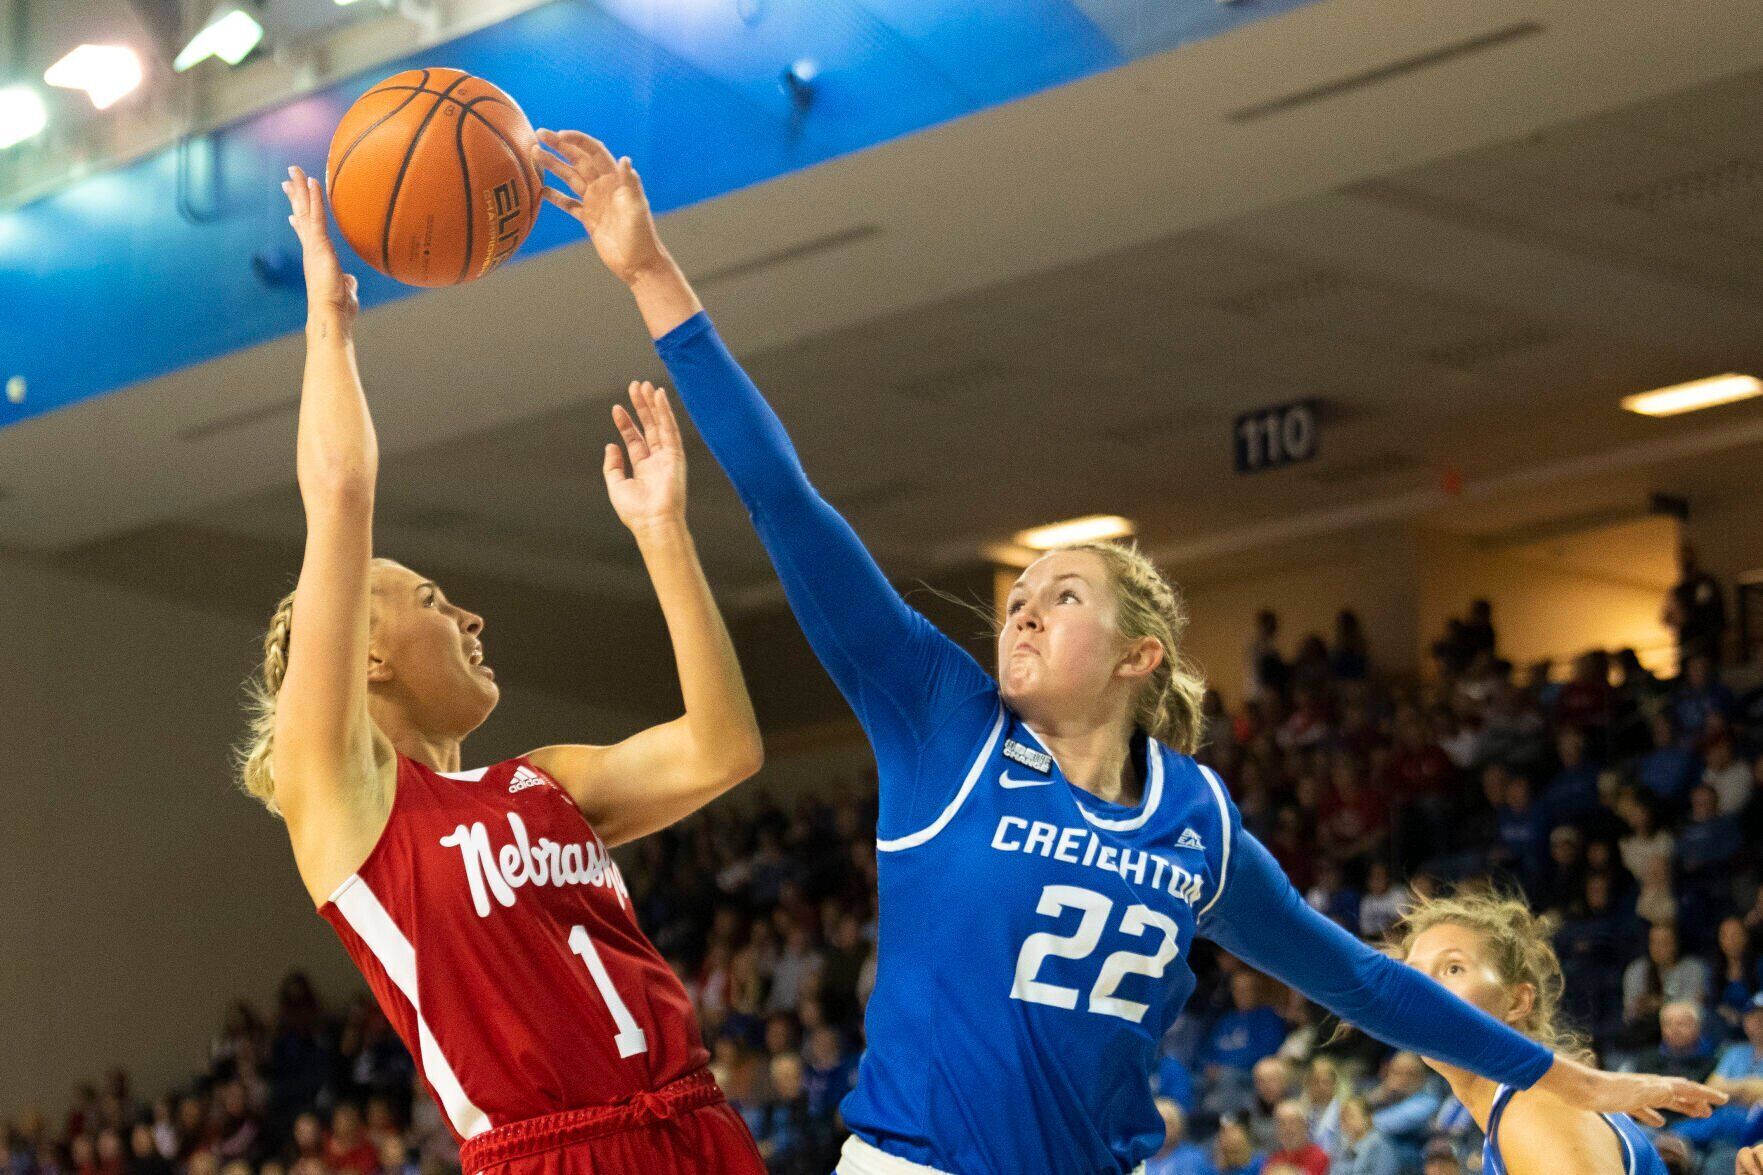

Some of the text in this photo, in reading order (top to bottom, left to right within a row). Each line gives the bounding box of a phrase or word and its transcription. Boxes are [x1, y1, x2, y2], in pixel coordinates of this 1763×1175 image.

[493, 177, 521, 262] ELIT
[1242, 405, 1313, 465] 110
[439, 811, 628, 918] Nebras
[567, 925, 648, 1059] 1
[1009, 884, 1179, 1024] 22
